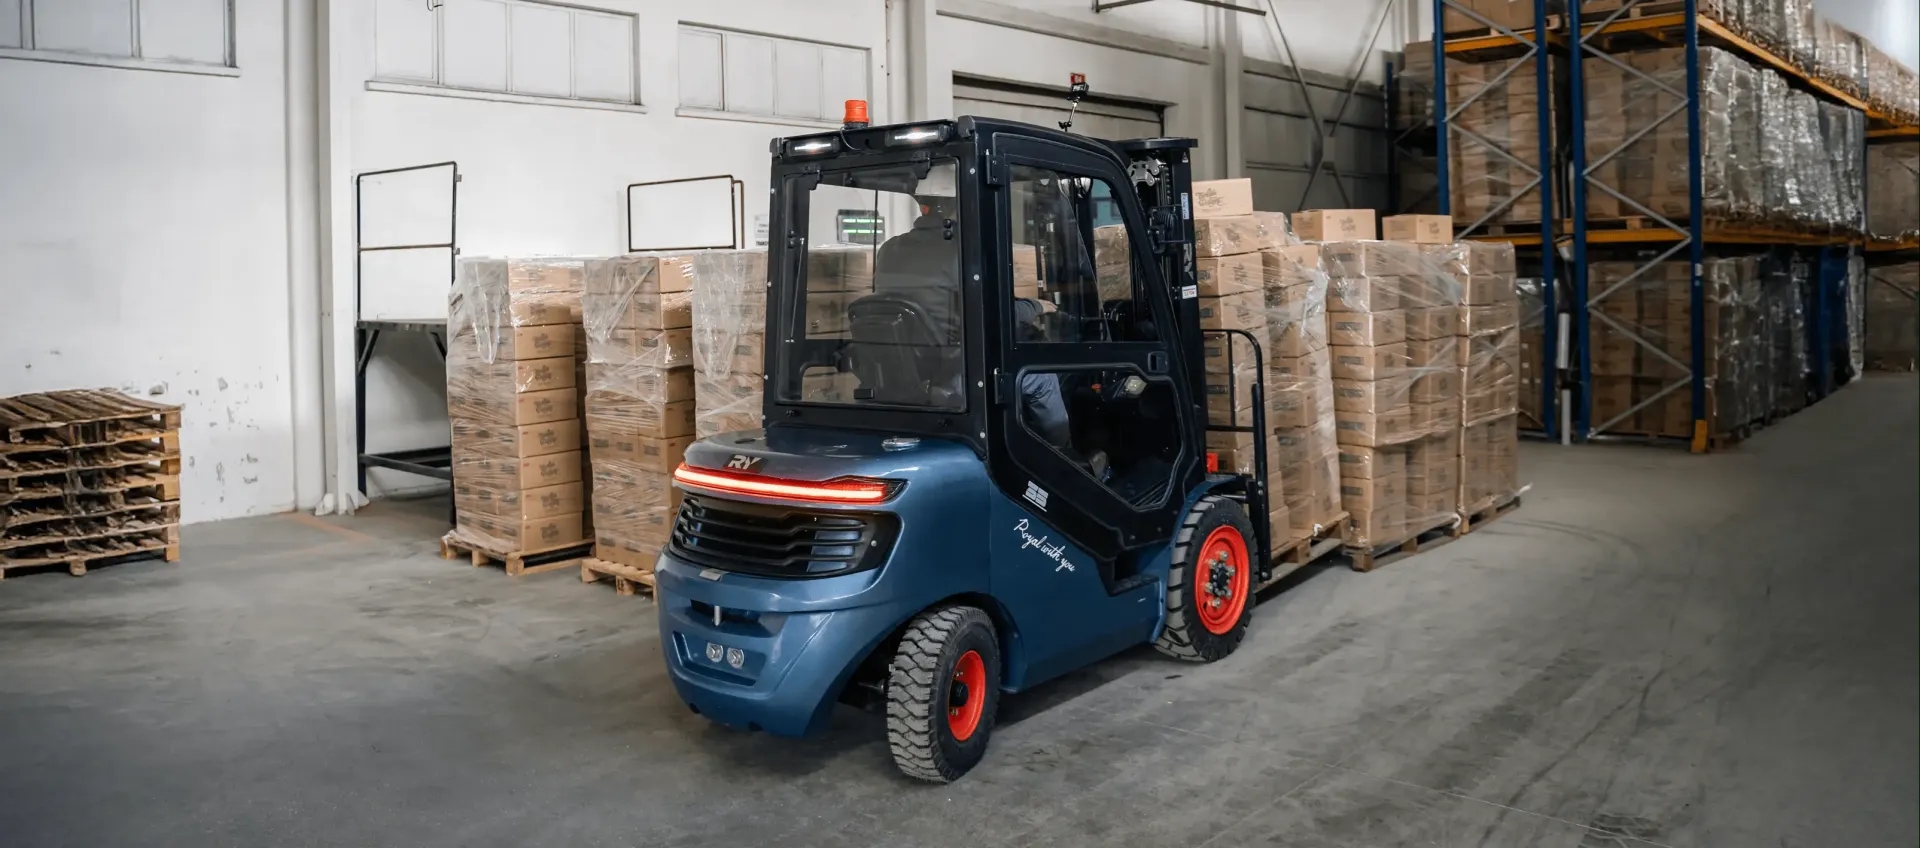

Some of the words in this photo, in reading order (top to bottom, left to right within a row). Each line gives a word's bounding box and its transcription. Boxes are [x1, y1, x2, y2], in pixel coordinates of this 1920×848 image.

[1183, 243, 1193, 280] RY
[728, 454, 762, 470] RY
[1014, 518, 1048, 549] Royal
[1041, 542, 1066, 562] with
[1056, 557, 1075, 572] you
